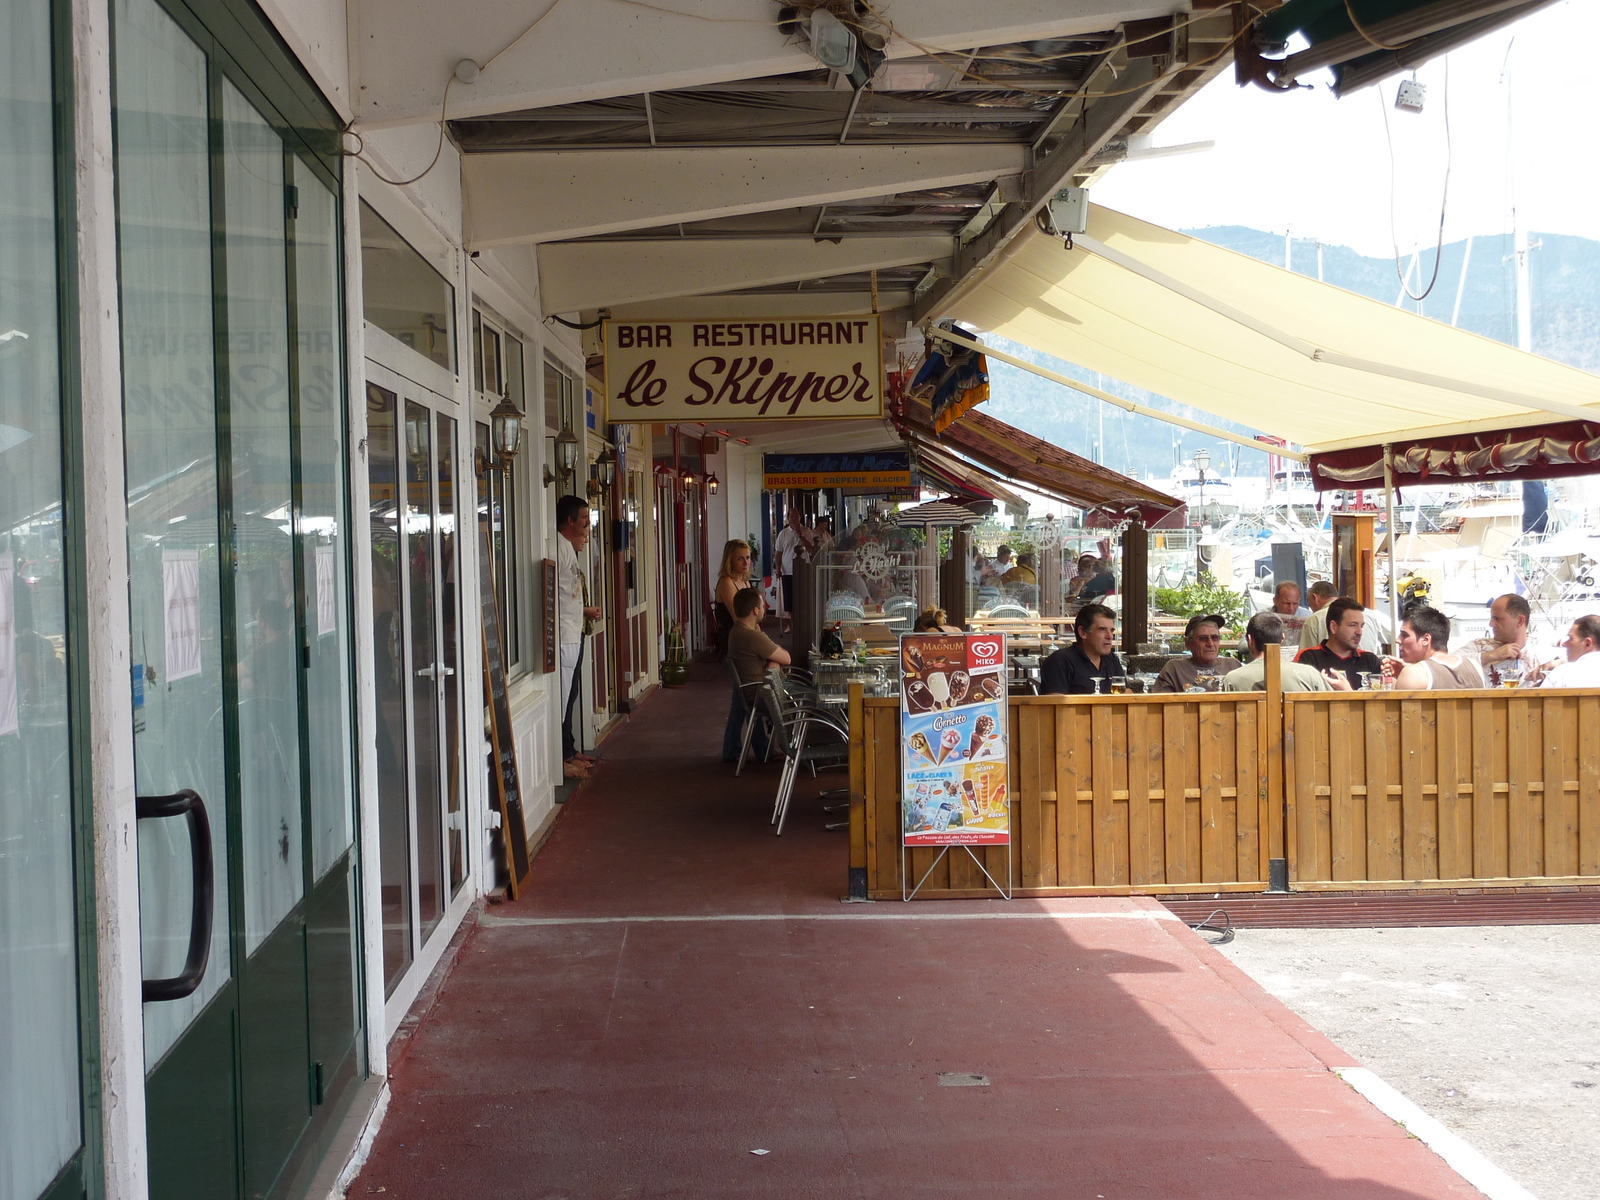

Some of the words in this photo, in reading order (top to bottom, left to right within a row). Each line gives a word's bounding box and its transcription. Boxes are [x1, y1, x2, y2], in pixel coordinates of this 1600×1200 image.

[618, 325, 672, 348] BAR
[693, 321, 869, 347] RESTAURANT
[617, 359, 667, 407] le
[782, 457, 815, 472] Bar
[817, 458, 836, 471] de
[840, 457, 857, 471] la
[861, 456, 894, 471] Mer
[767, 476, 818, 485] BRASSERIE
[923, 642, 964, 651] MAGNUM
[933, 715, 967, 731] Cornetto
